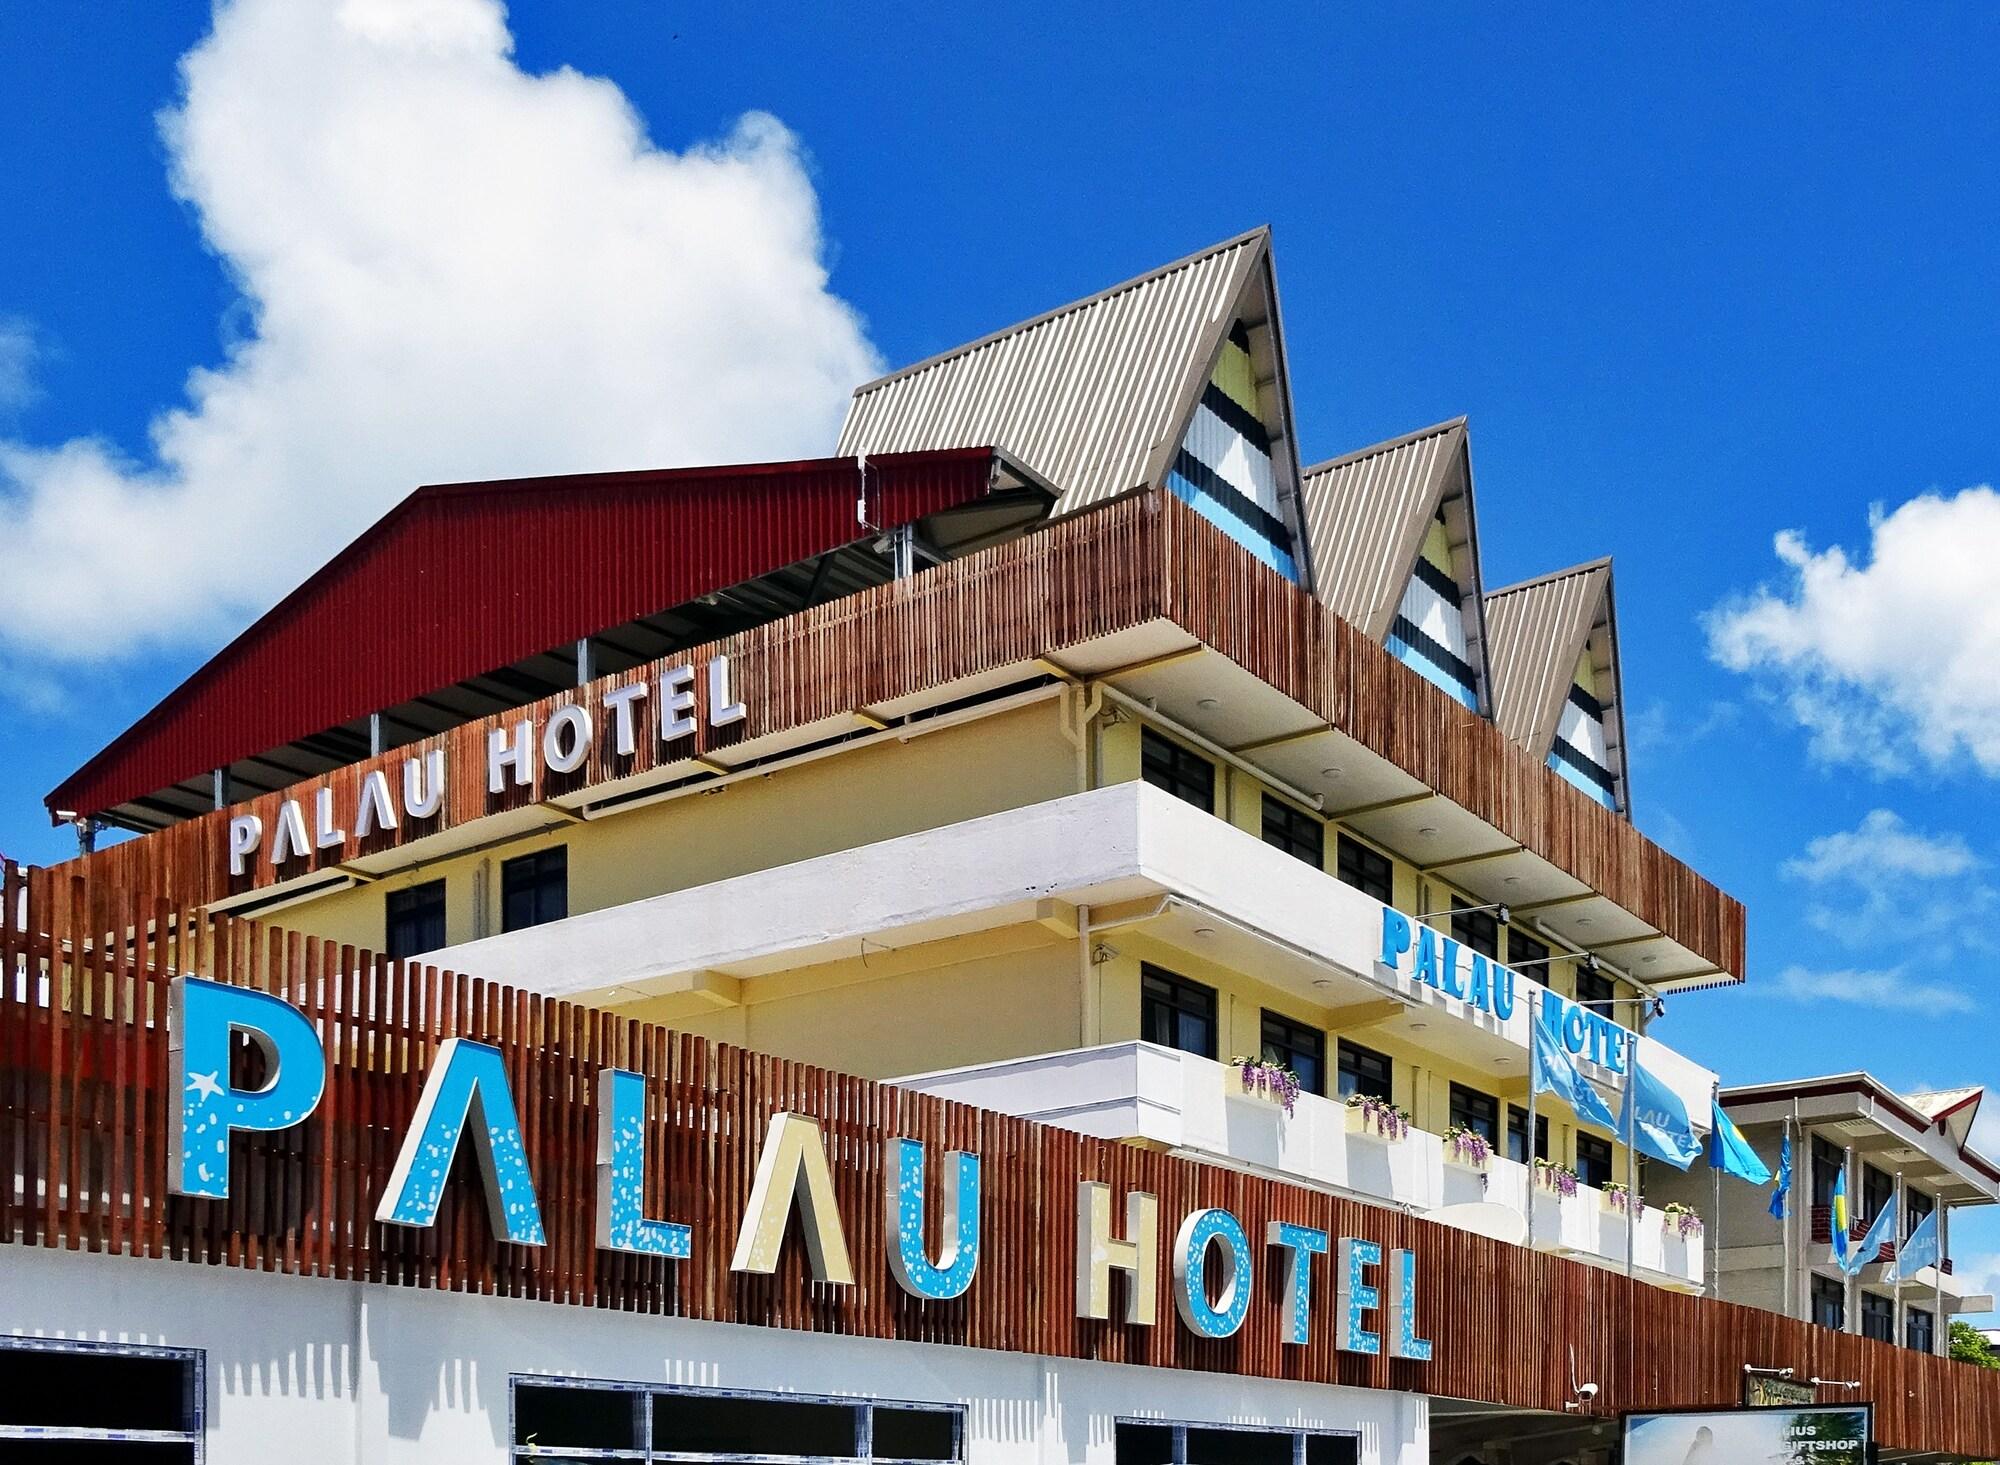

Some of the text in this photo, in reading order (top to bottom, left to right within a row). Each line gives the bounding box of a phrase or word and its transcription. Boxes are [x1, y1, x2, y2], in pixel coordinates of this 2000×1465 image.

[230, 655, 746, 876] PALAU HOTEL
[1381, 907, 1515, 1020] PALAU
[167, 974, 1432, 1361] PALAU HOTEL
[1784, 1440, 1858, 1451] GIFTSHOP
